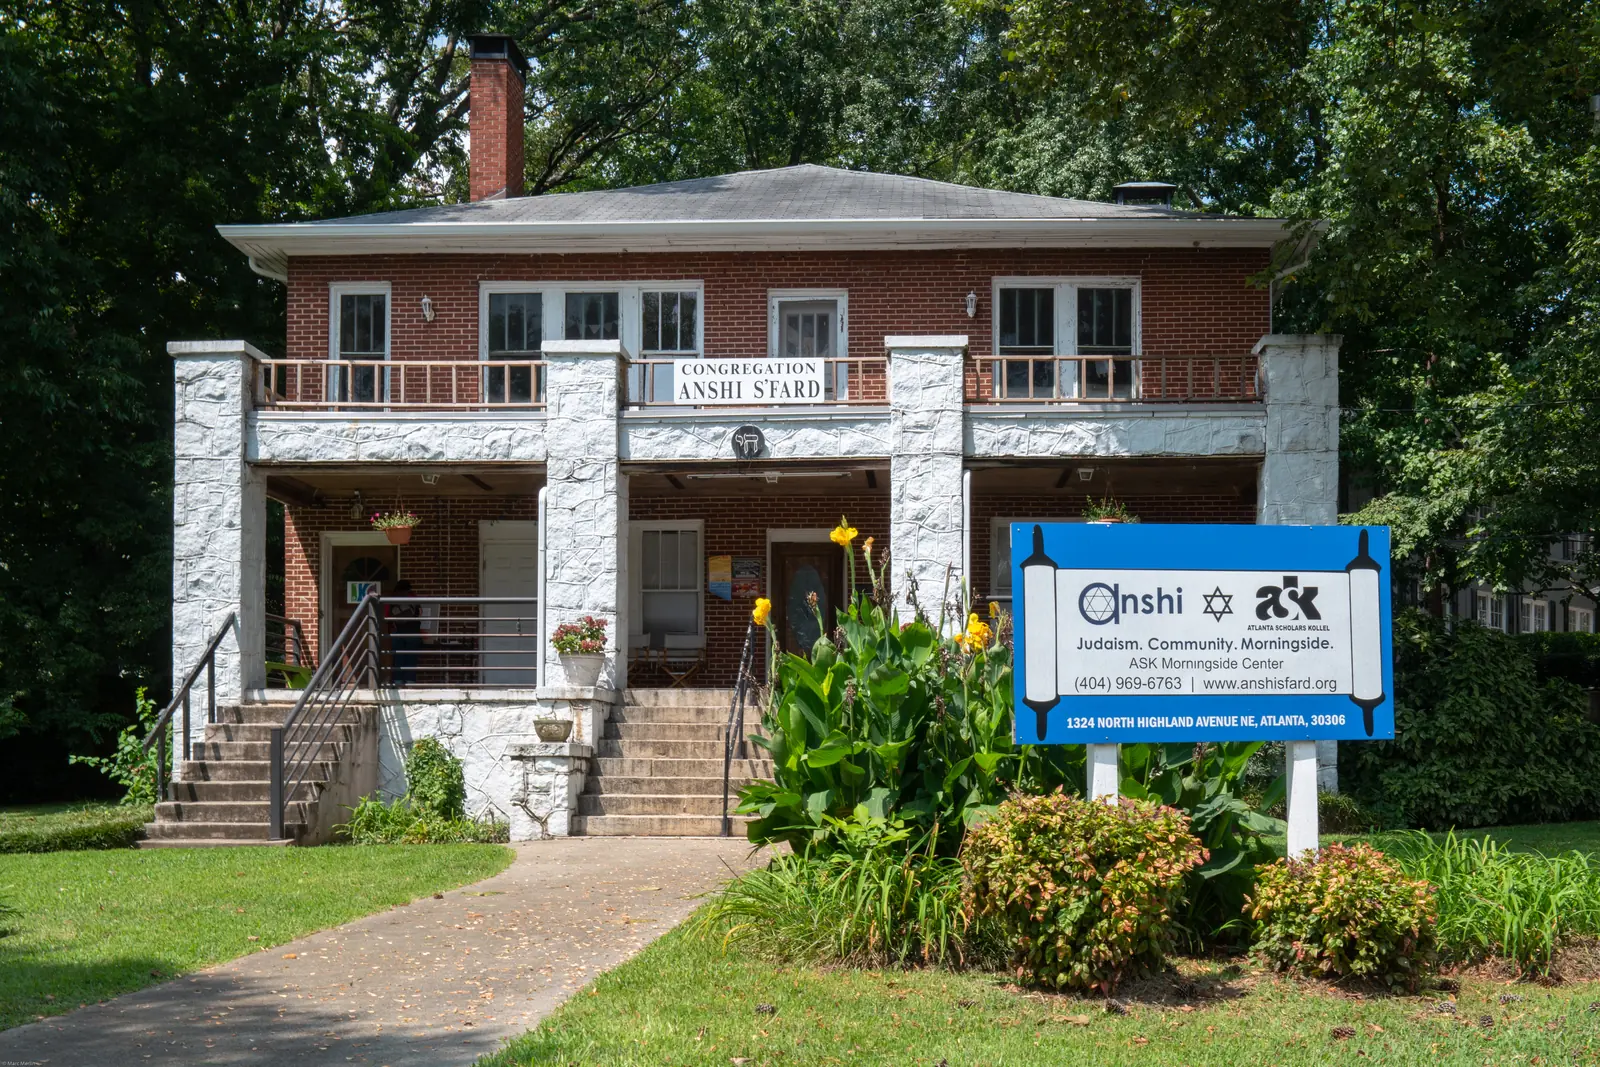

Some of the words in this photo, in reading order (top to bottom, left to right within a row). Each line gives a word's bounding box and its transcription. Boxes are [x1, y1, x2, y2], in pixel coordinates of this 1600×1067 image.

[681, 362, 816, 376] CONGREGATION
[679, 380, 742, 400] ANSHI
[753, 378, 821, 399] S'FARD
[1076, 637, 1143, 651] Judaism.
[1147, 637, 1238, 653] Community.
[1240, 636, 1334, 652] Morningside.
[1129, 657, 1158, 669] ASK
[1161, 657, 1238, 672] Morningside
[1242, 657, 1284, 669] Center
[1074, 676, 1112, 693] (404)
[1115, 676, 1182, 690] 969-6763
[1203, 676, 1337, 692] www.anshisfard.org
[1067, 717, 1095, 729] 1324
[1097, 716, 1135, 728] NORTH
[1137, 716, 1194, 728] HIGHLAND
[1195, 715, 1238, 727] AVENUE
[1240, 715, 1259, 729] NE,
[1260, 714, 1309, 728] ATLANTA,
[1311, 714, 1346, 726] 30306
